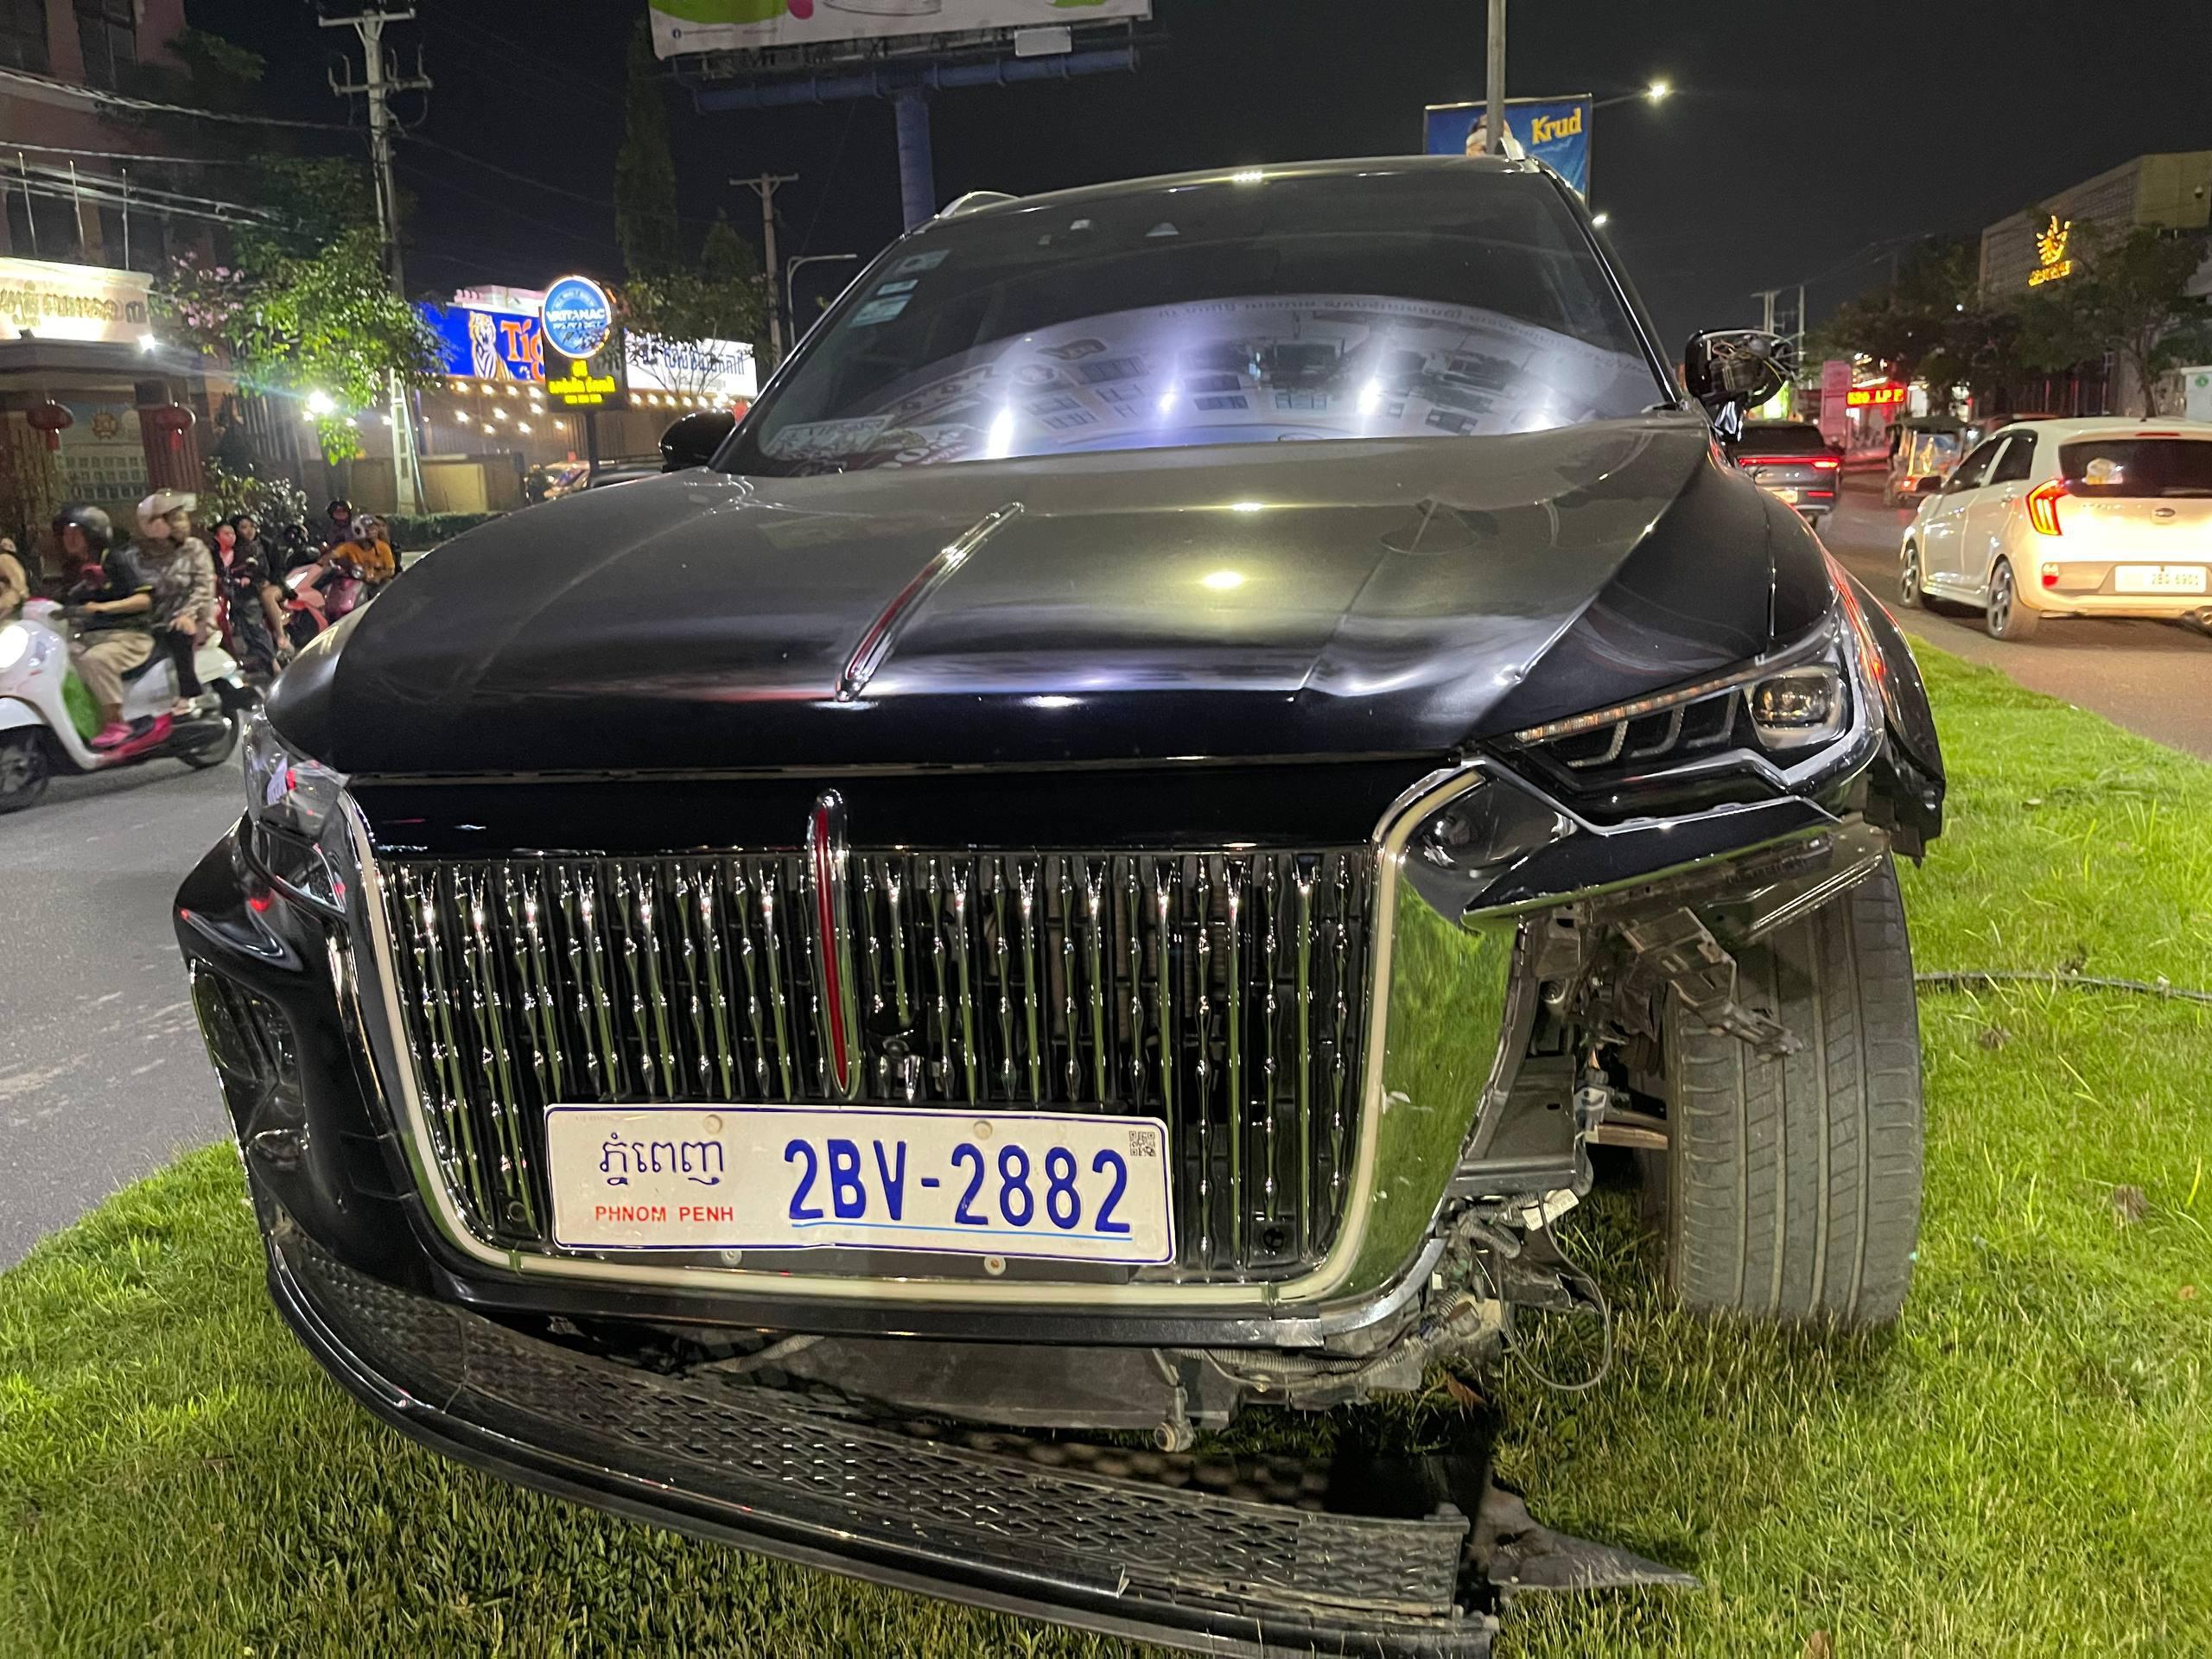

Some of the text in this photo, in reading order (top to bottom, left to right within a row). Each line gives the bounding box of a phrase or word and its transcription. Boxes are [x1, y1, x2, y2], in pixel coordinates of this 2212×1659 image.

[1531, 106, 1582, 145] Krud
[600, 1132, 723, 1185] ភ្នំពេញ
[784, 1138, 1131, 1233] 2BV-2882
[595, 1206, 734, 1222] PHNOM PENH
